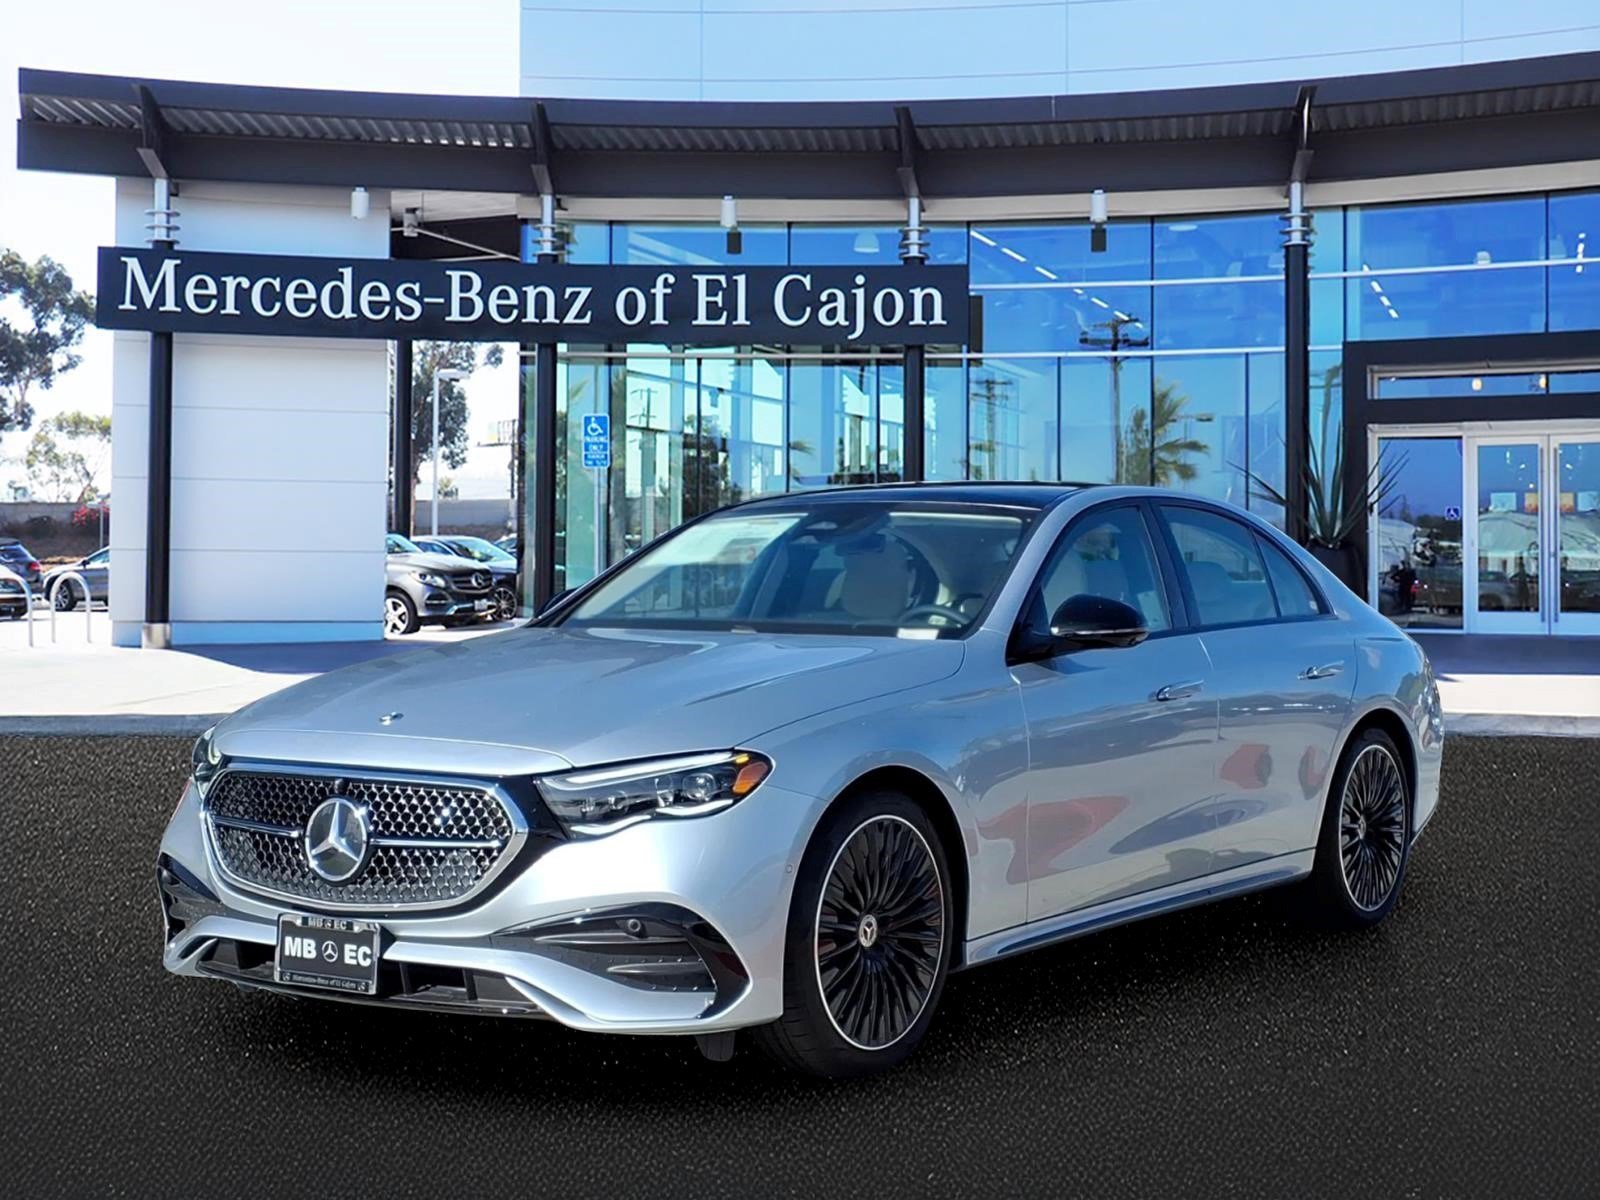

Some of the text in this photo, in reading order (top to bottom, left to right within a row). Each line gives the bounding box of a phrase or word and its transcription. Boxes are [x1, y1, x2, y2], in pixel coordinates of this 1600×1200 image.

[118, 256, 948, 340] Mercedes-Benz of El Cajon
[284, 936, 372, 967] MB EC
